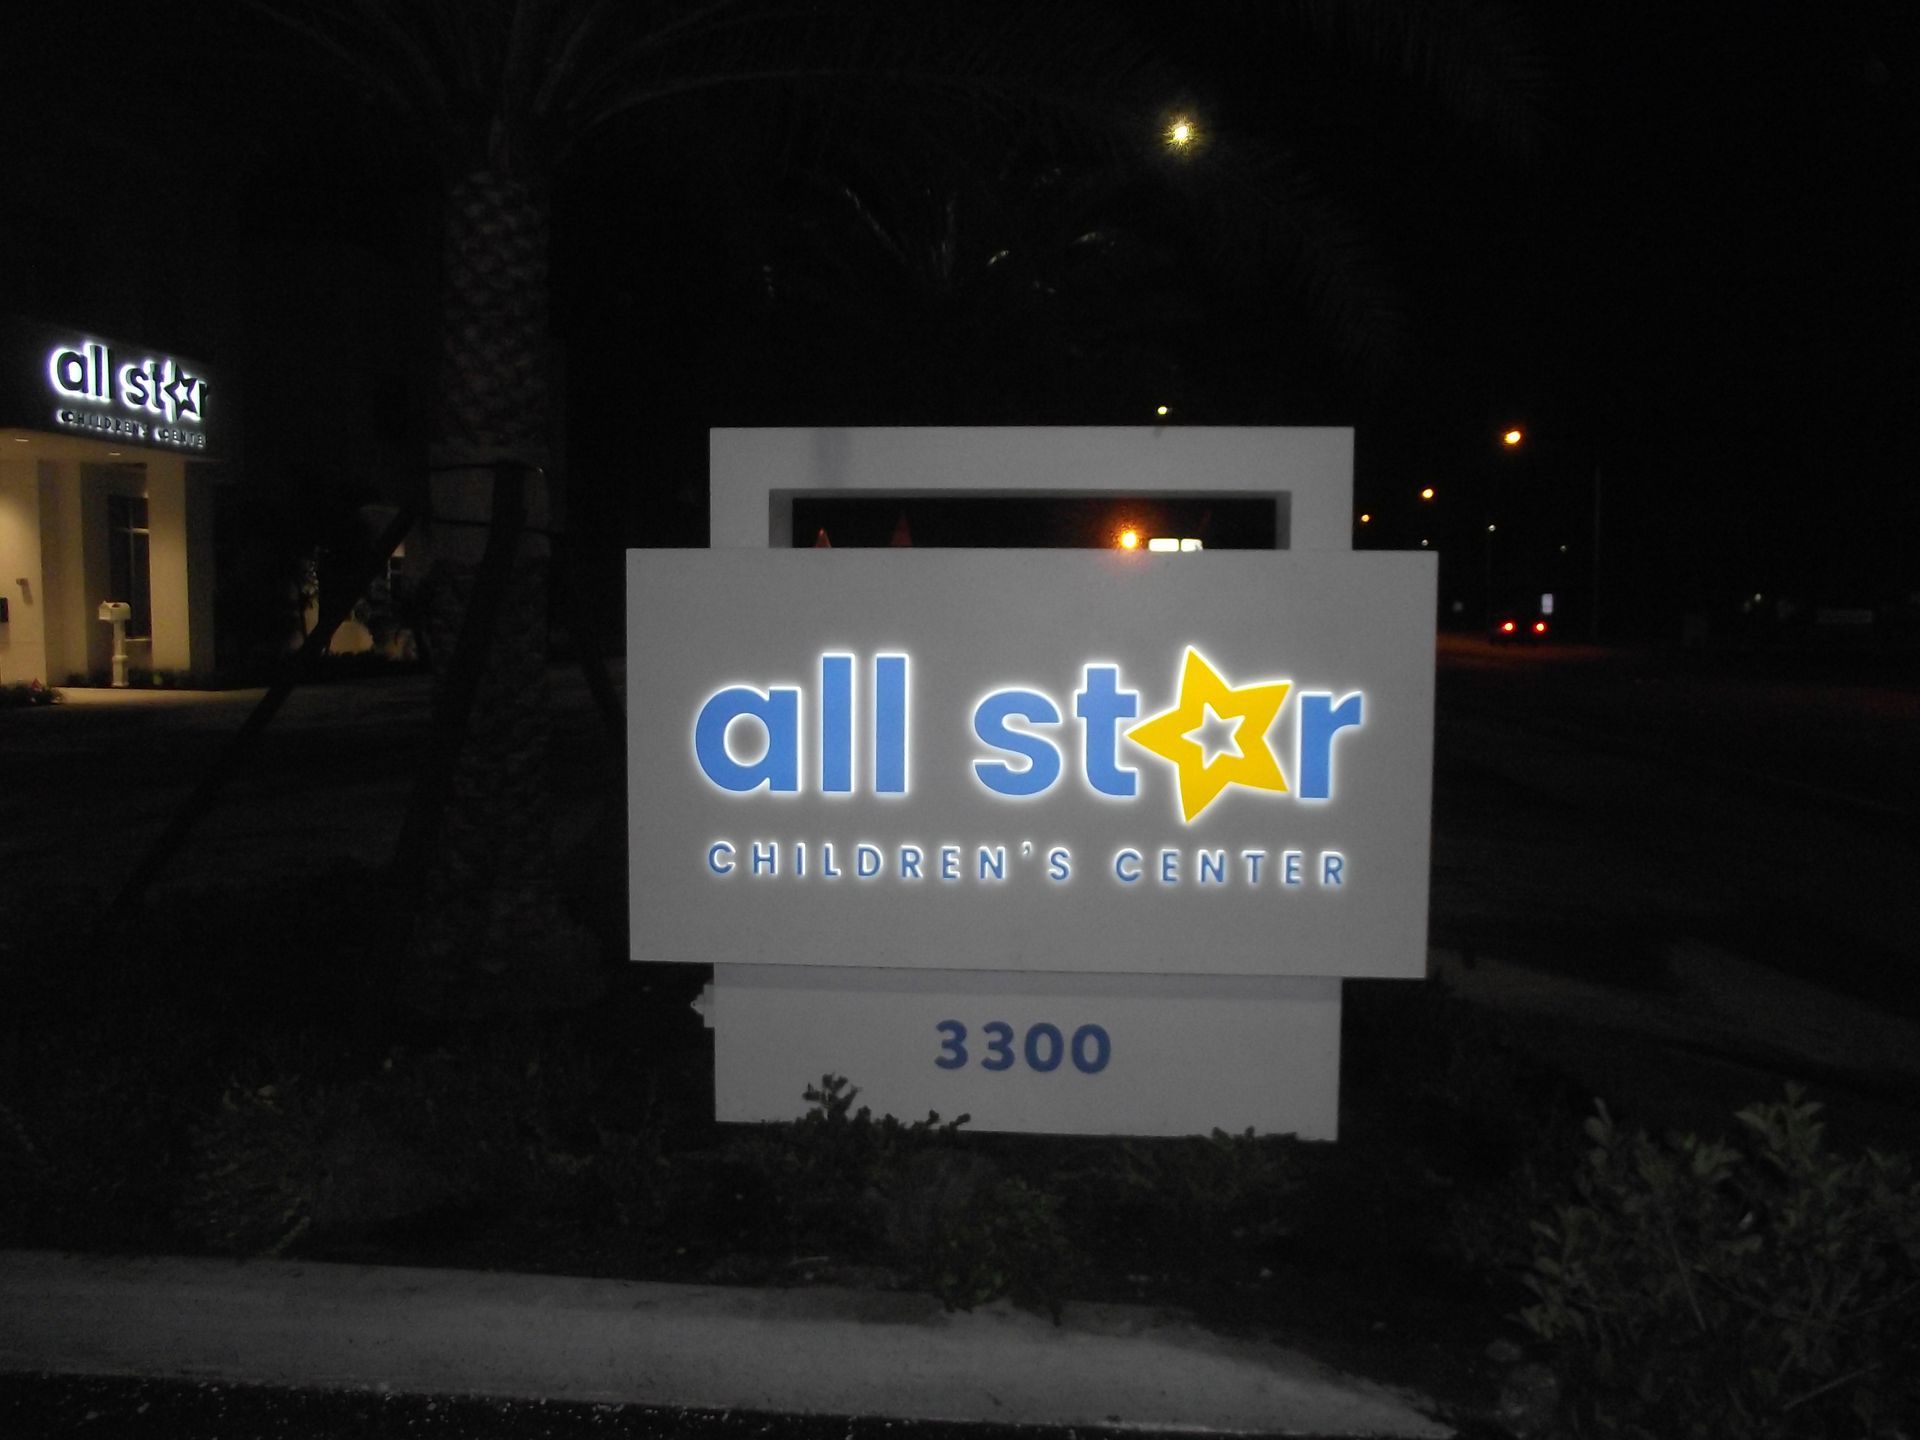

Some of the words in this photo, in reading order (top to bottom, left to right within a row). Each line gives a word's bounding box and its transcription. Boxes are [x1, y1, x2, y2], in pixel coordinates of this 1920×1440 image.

[53, 344, 111, 400] all
[59, 410, 149, 438] CHILDRENS
[694, 652, 909, 795] all
[707, 840, 1071, 881] CHILDREN'S
[1114, 847, 1346, 885] CENTER
[934, 1019, 1111, 1074] 3300
